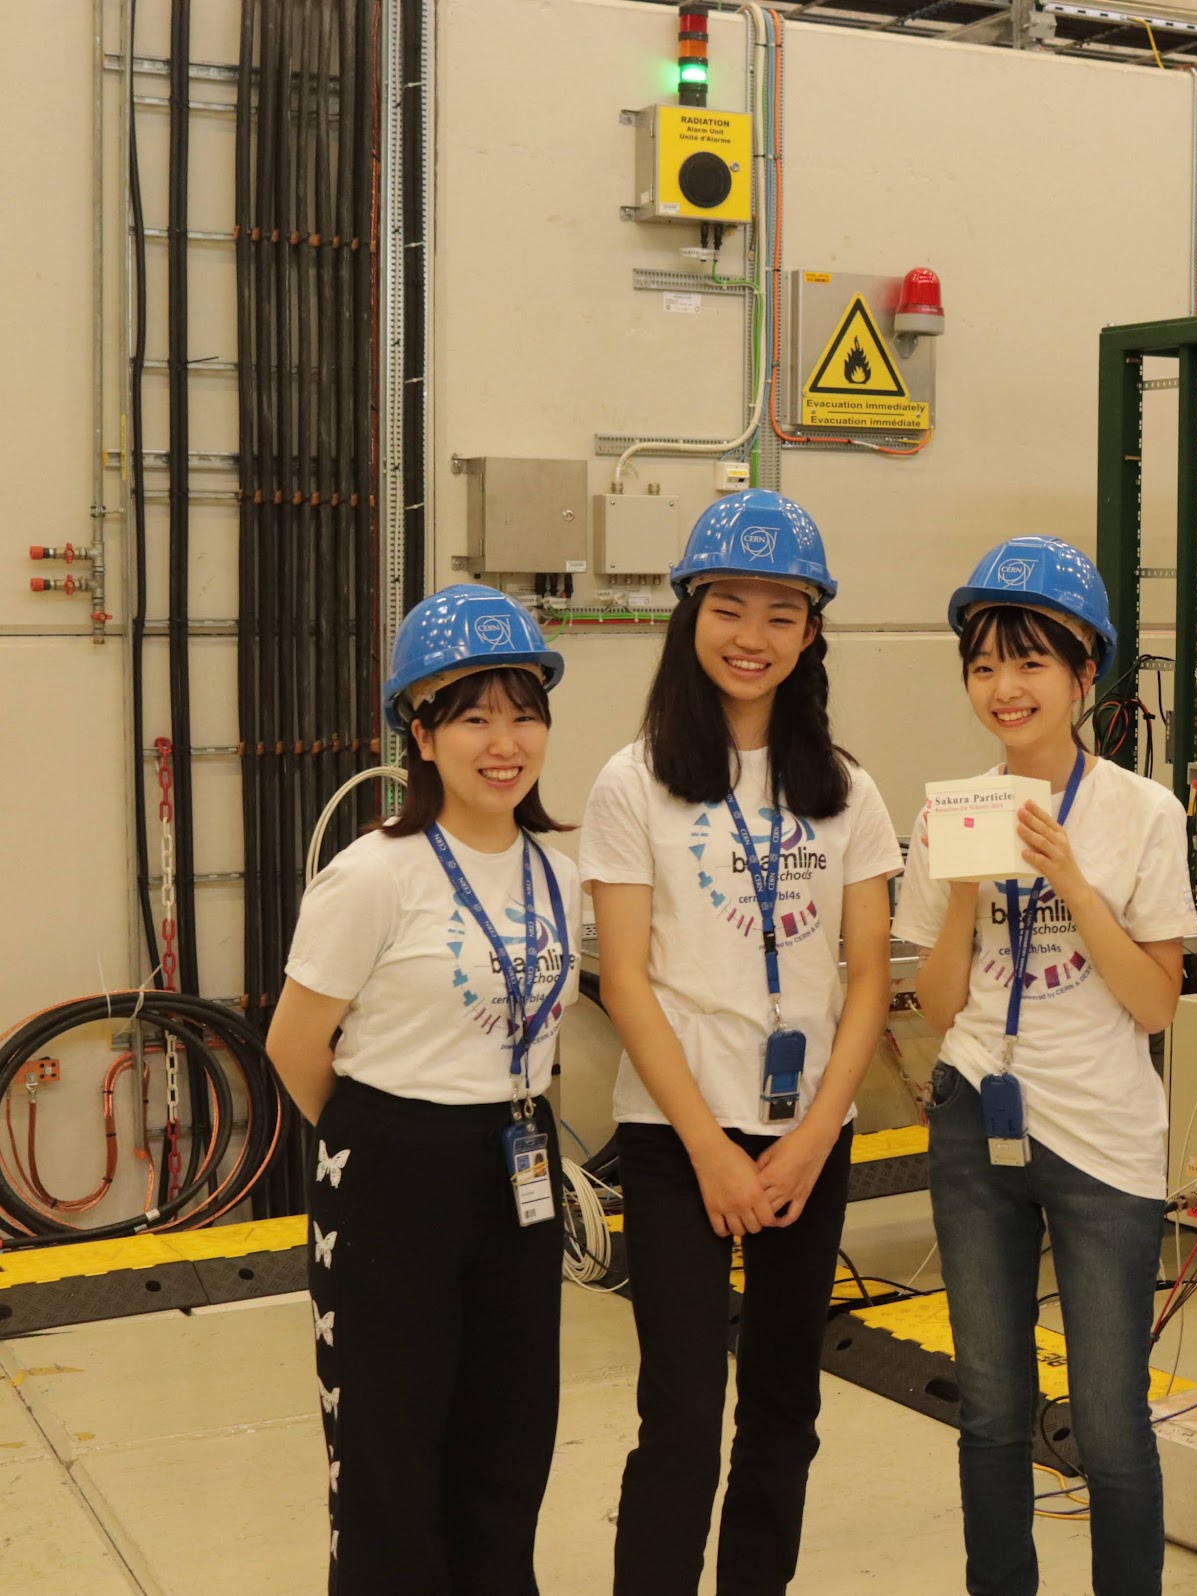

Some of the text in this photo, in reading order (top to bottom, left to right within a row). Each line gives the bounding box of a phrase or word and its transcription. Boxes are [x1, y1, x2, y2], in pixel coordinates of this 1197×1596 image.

[681, 116, 730, 127] RADIATION
[806, 400, 925, 413] Evacuation immediately
[811, 416, 921, 427] Evacuation immédiate
[744, 535, 766, 543] CERN
[935, 796, 969, 806] Sakura
[434, 833, 447, 851] CERN
[741, 828, 751, 845] CERN
[772, 827, 780, 843] CERN
[732, 847, 827, 873] bamline
[768, 873, 776, 890] CERN
[778, 869, 813, 881] chools
[458, 877, 472, 895] CERN
[754, 874, 764, 892] CERN
[485, 920, 497, 938] CERN
[528, 921, 536, 938] CERN
[1032, 922, 1077, 935] schools
[794, 931, 811, 943] CERN
[1055, 984, 1075, 996] CERN
